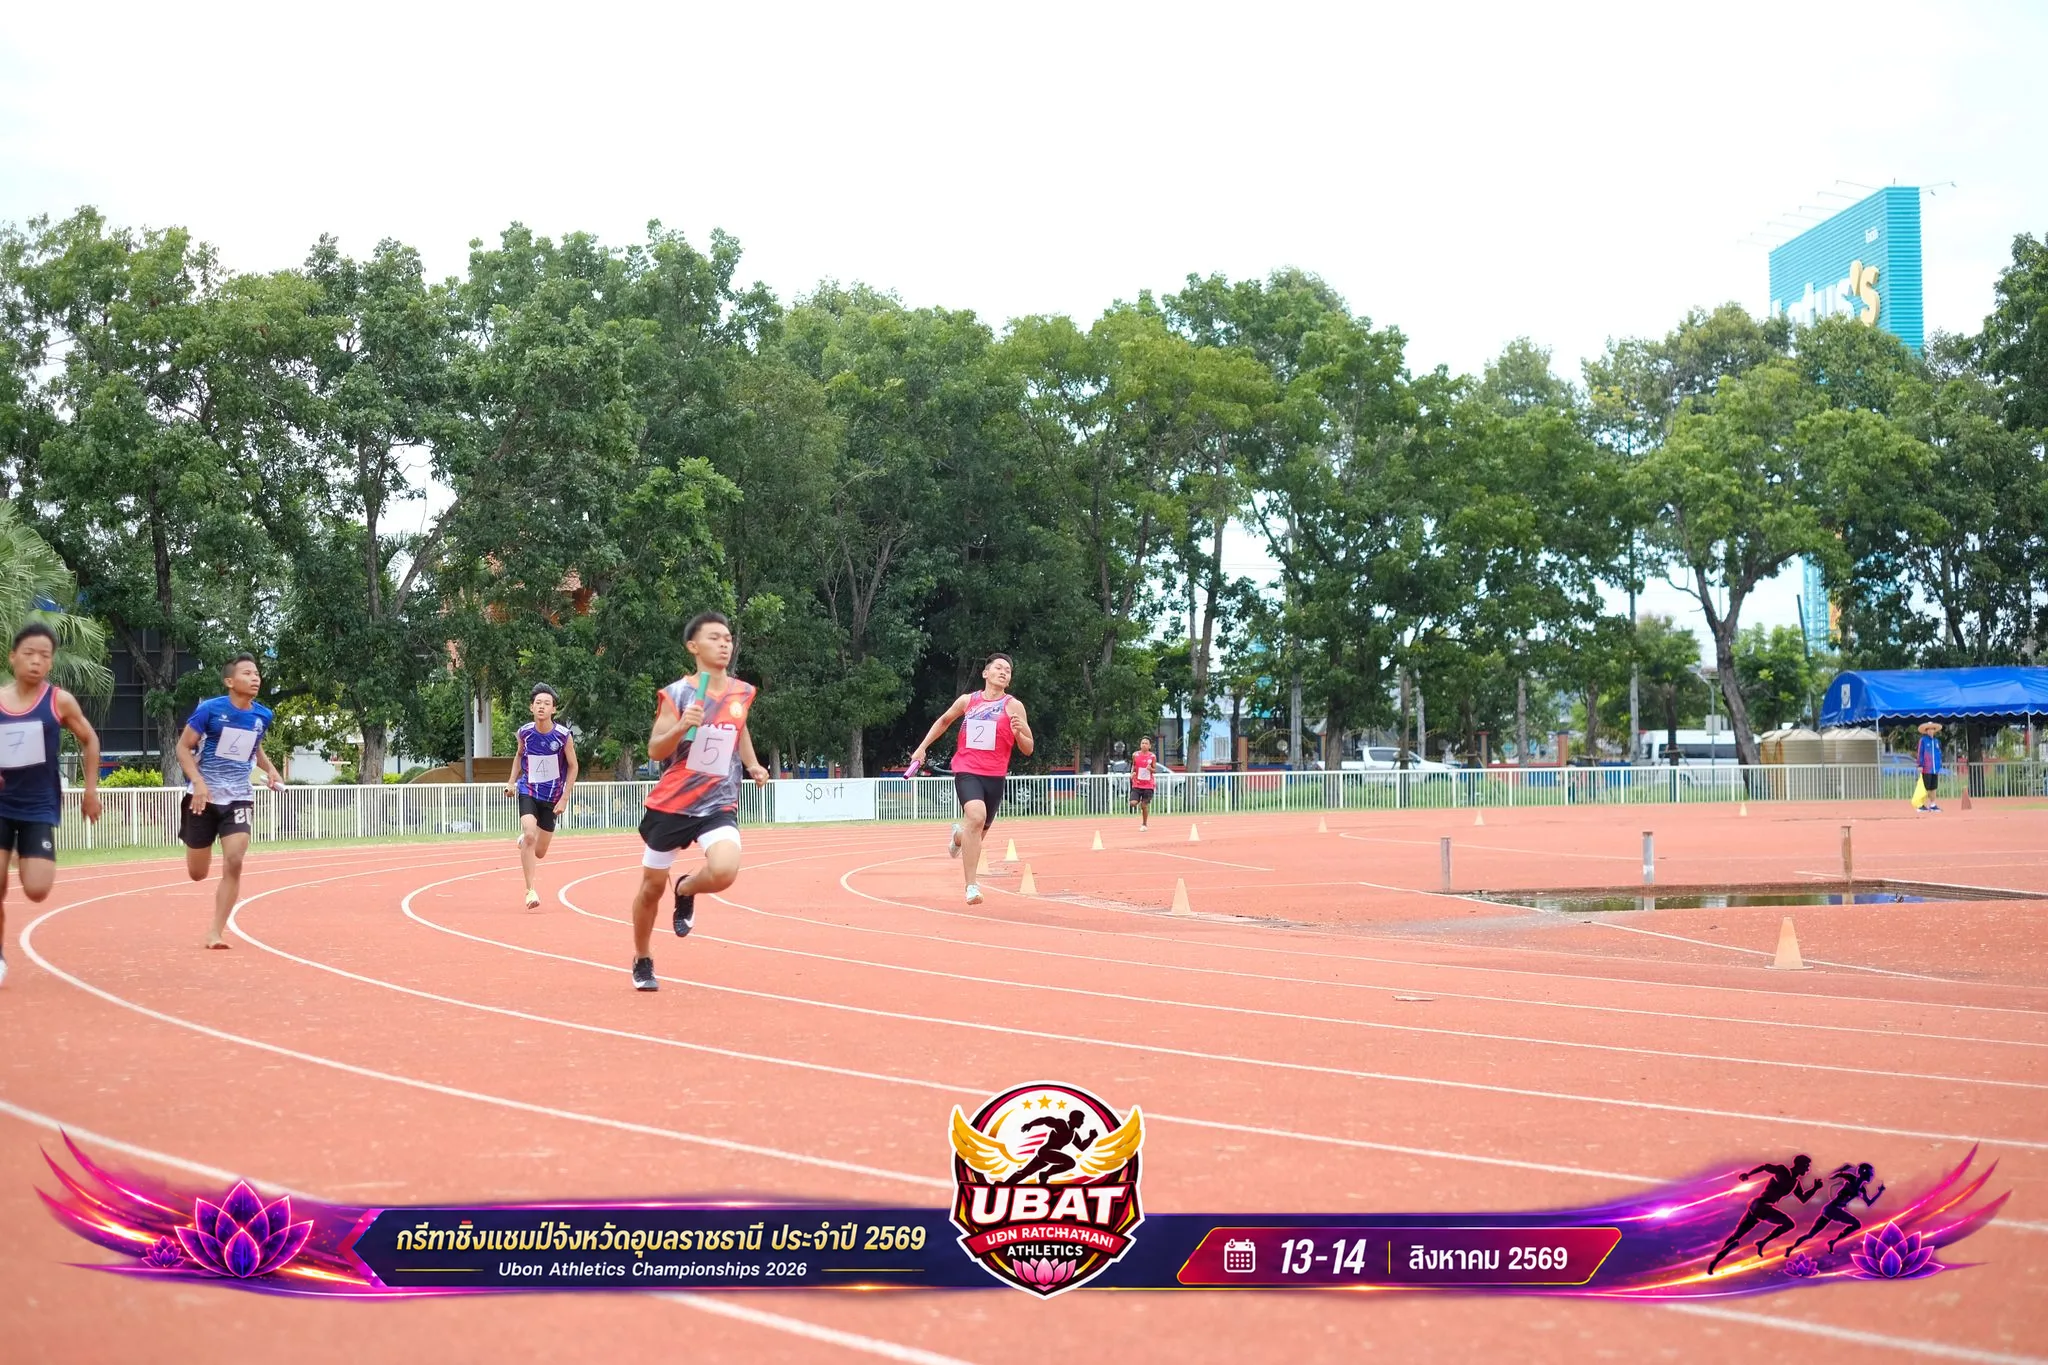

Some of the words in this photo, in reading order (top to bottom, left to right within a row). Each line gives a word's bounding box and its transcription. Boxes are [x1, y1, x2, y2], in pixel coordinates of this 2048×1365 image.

[5, 730, 25, 754] 7
[230, 734, 242, 752] 6
[973, 725, 985, 743] 2
[701, 737, 724, 766] 5
[536, 759, 548, 777] 4
